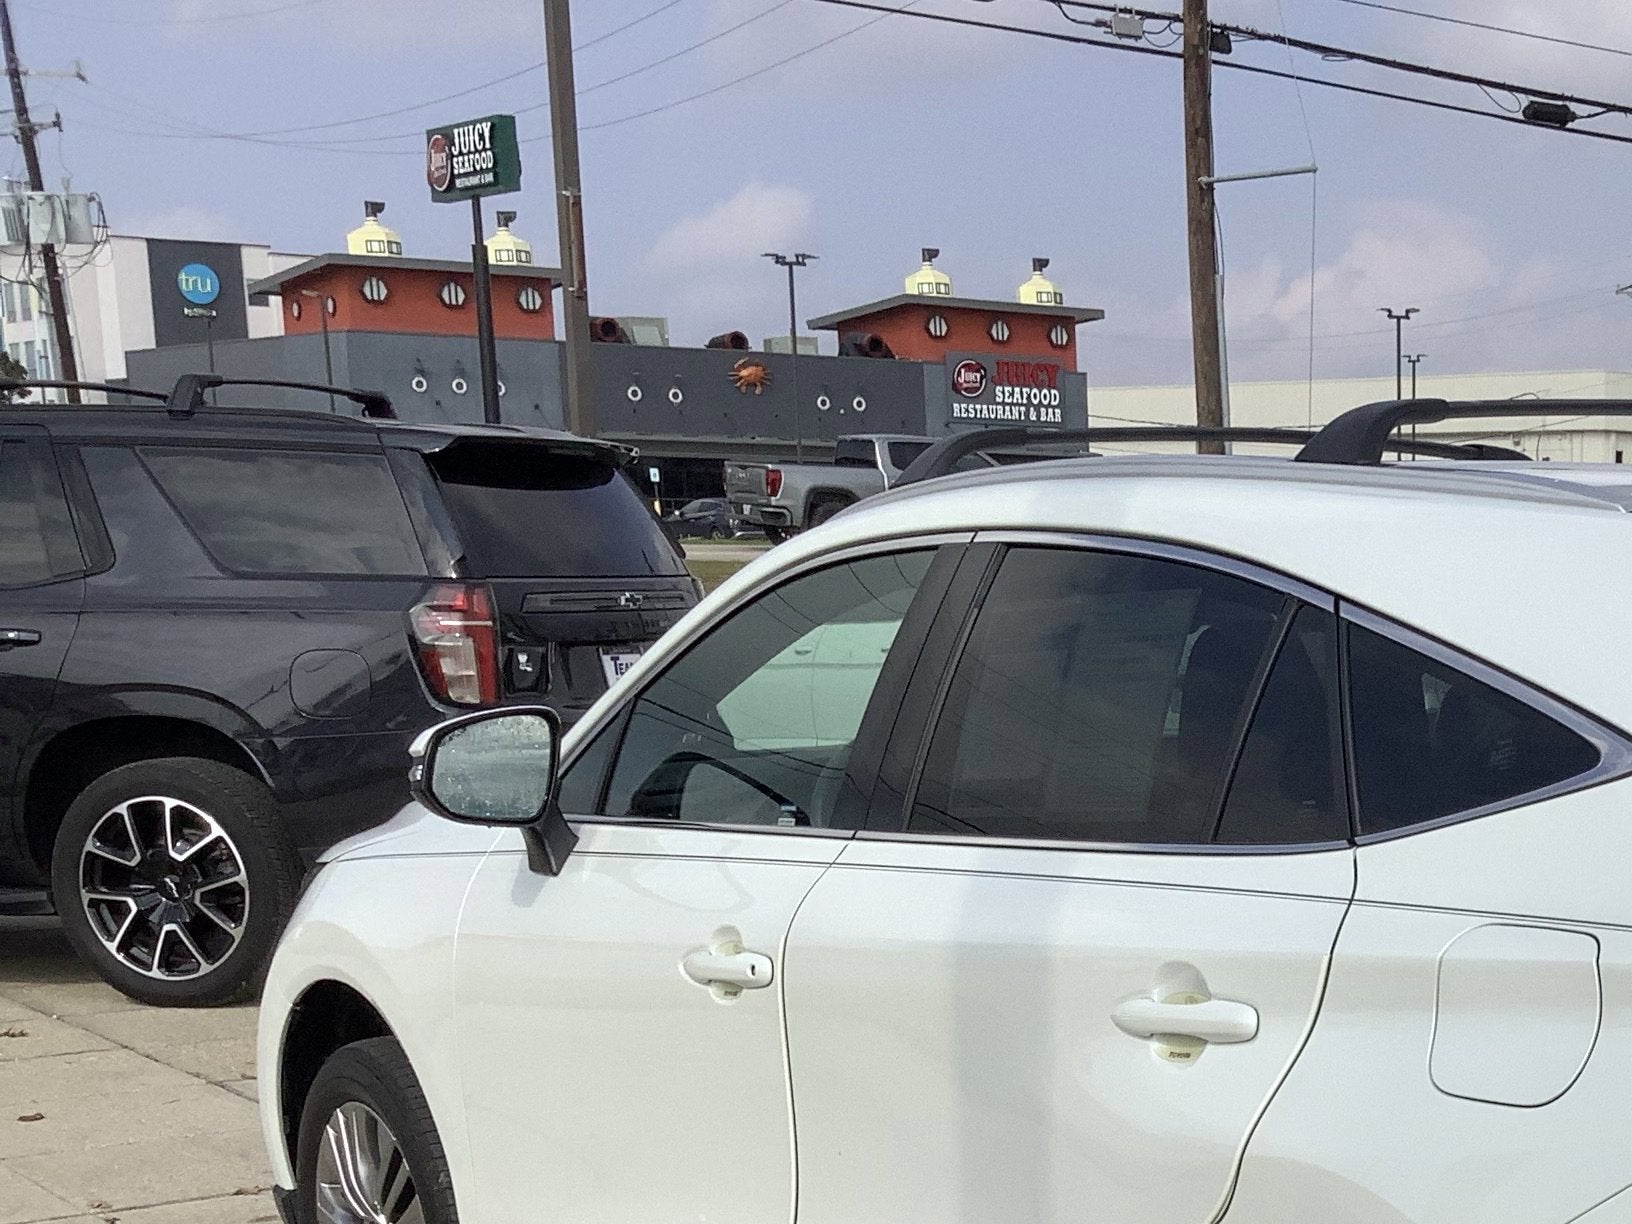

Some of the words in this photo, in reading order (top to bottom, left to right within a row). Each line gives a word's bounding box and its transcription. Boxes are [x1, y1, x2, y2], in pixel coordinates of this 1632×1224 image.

[451, 122, 491, 155] JUICY
[453, 150, 493, 175] SEAFOOD
[178, 272, 212, 293] tru
[991, 361, 1060, 388] JUICY
[995, 386, 1060, 406] SEAFOOD
[952, 403, 1026, 420] RESTAURANT
[1029, 407, 1037, 421] &
[1040, 407, 1061, 422] BAR
[610, 656, 633, 675] TEA
